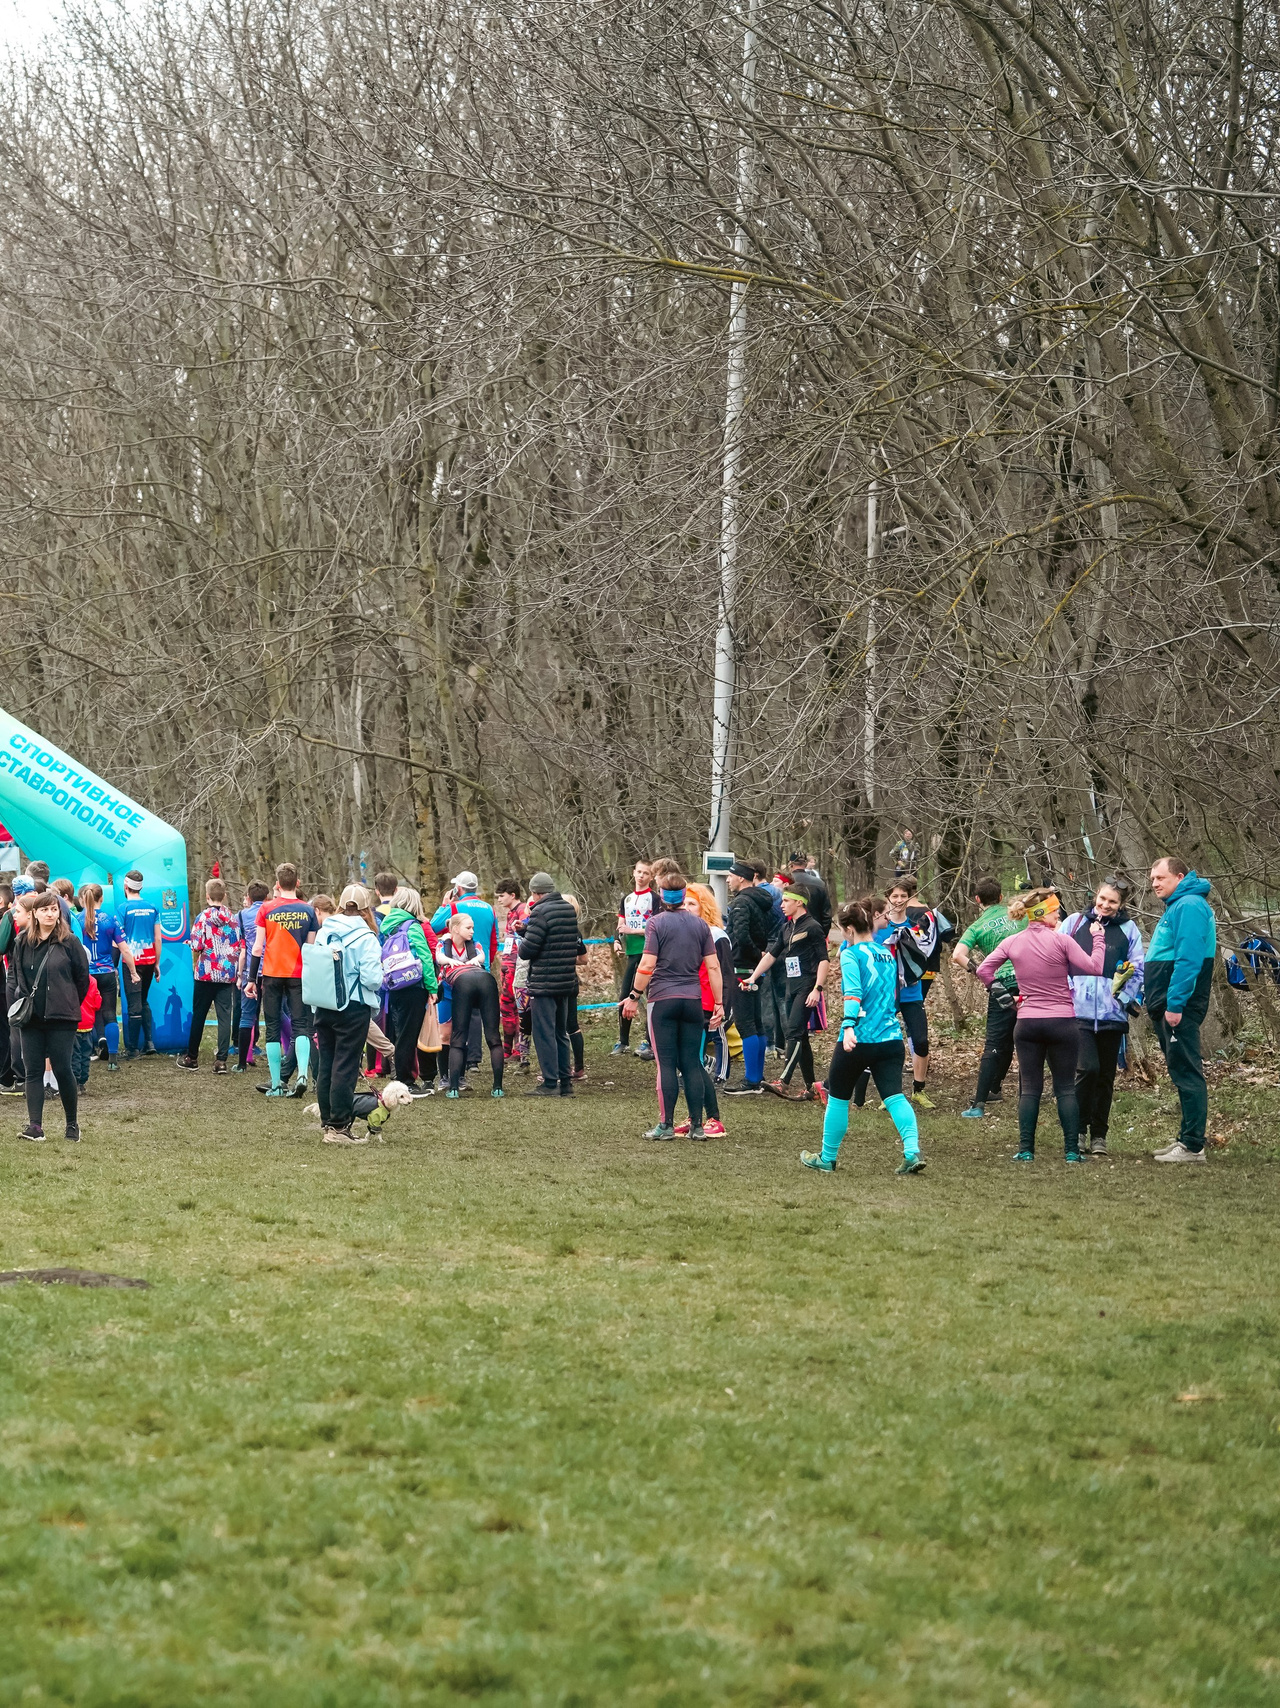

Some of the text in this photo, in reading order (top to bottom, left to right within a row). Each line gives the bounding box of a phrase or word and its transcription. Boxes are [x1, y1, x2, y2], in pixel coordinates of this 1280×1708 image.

[9, 733, 145, 828] СПОРТИВНОЕ
[268, 911, 308, 922] UGRESHA
[278, 921, 303, 930] TRAIL
[873, 953, 893, 964] КАТЯ
